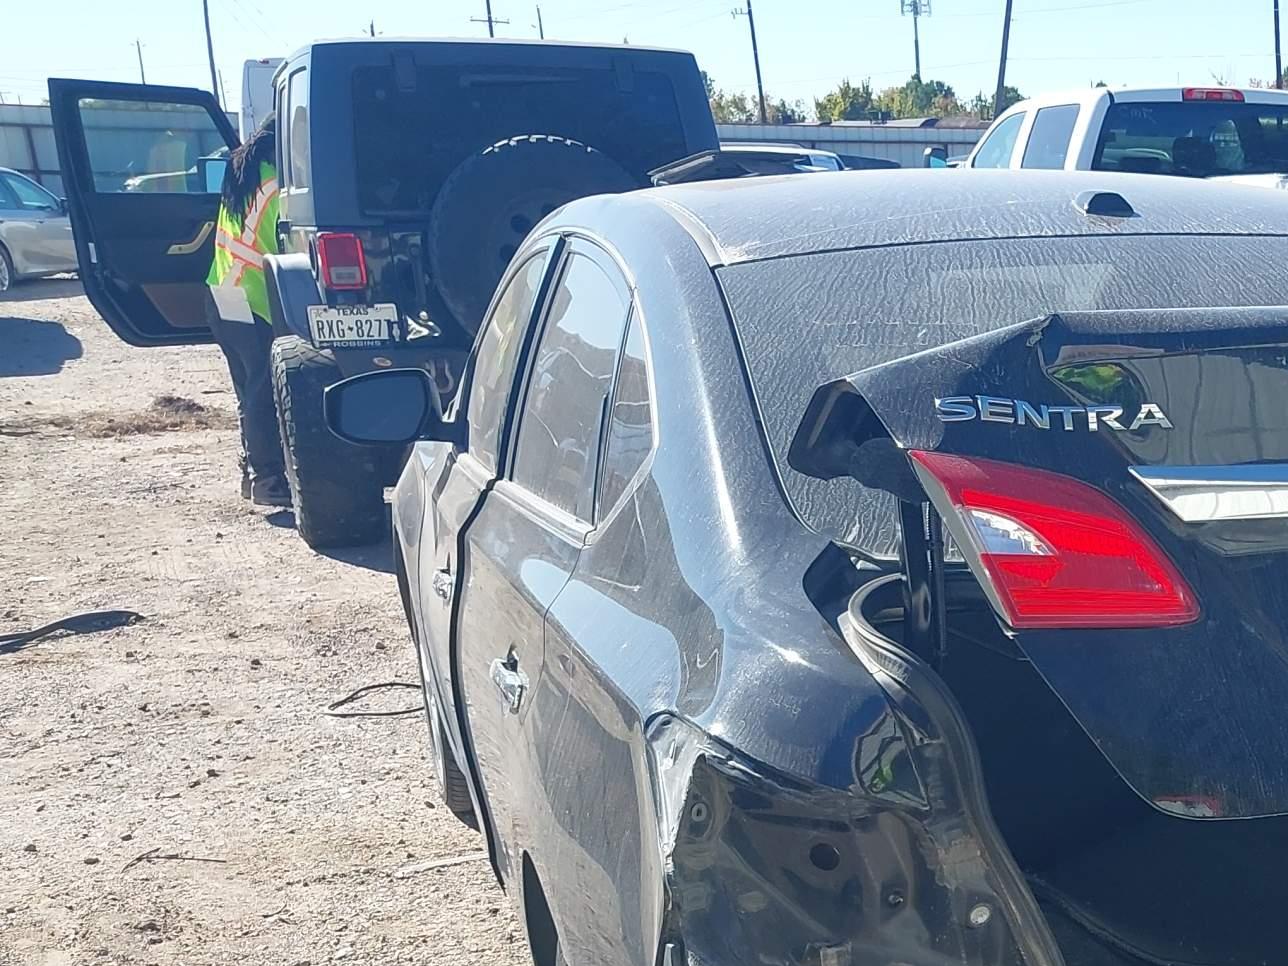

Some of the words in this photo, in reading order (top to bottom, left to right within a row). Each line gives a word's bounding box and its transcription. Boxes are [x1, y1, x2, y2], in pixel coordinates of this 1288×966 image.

[336, 307, 369, 317] TEXAS
[316, 319, 346, 340] RXG
[934, 394, 1174, 433] SENTRA
